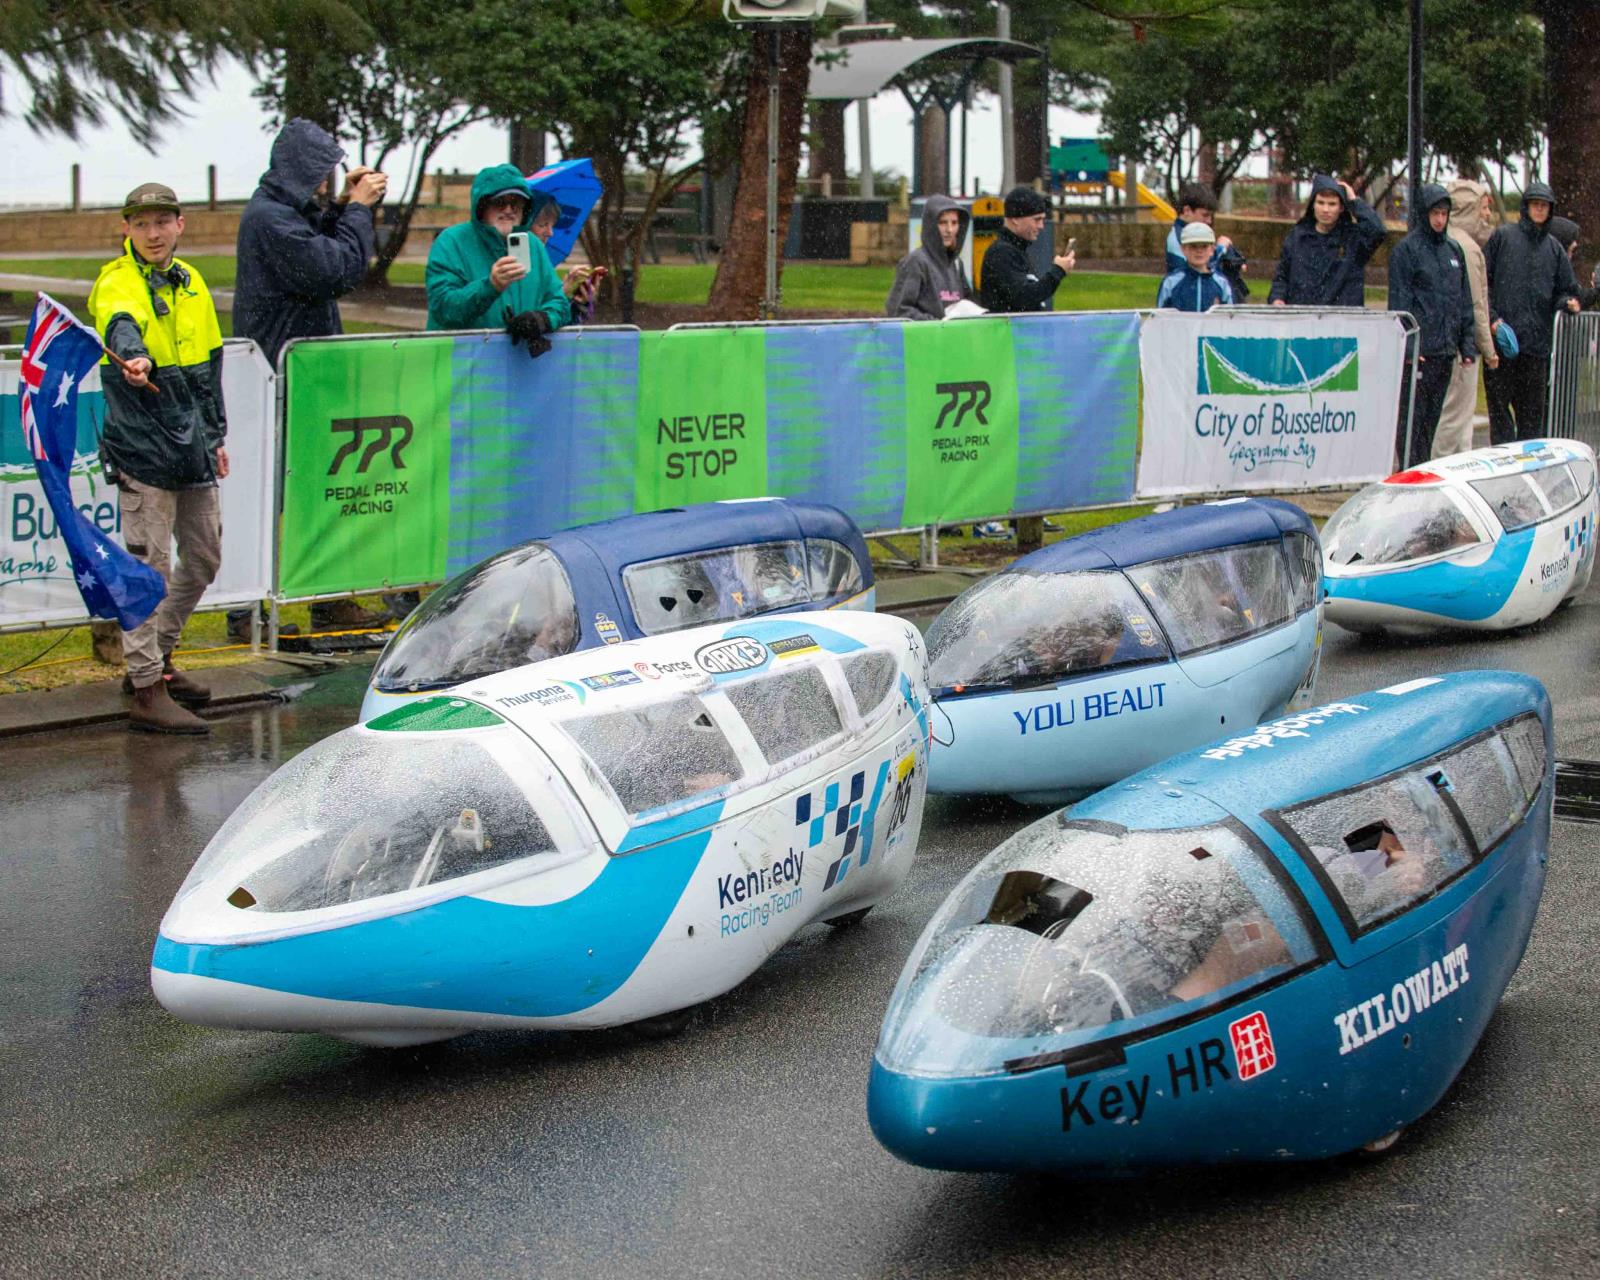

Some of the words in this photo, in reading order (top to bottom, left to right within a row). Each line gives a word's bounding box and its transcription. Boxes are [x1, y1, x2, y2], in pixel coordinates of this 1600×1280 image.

[657, 413, 745, 445] NEVER
[1195, 403, 1239, 447] City
[1243, 402, 1266, 436] of
[1271, 401, 1356, 436] Busselton
[932, 437, 963, 451] PEDAL
[964, 434, 990, 448] PRIX
[941, 450, 978, 464] RACING
[1229, 435, 1290, 472] Geographe
[1293, 437, 1317, 469] Bay
[665, 448, 737, 479] STOP
[324, 484, 370, 502] PEDAL
[374, 481, 409, 496] PRIX
[340, 500, 393, 517] RACING
[1540, 552, 1569, 580] Kennedy
[651, 661, 693, 674] Force
[496, 685, 565, 709] Thuroona
[537, 692, 574, 706] Services
[1013, 698, 1075, 735] YOU
[1084, 683, 1166, 721] BEAUT
[717, 846, 804, 910] Kennedy
[1333, 942, 1470, 1056] KILOWATT
[1060, 1074, 1151, 1133] Key
[1167, 1037, 1232, 1099] HR
